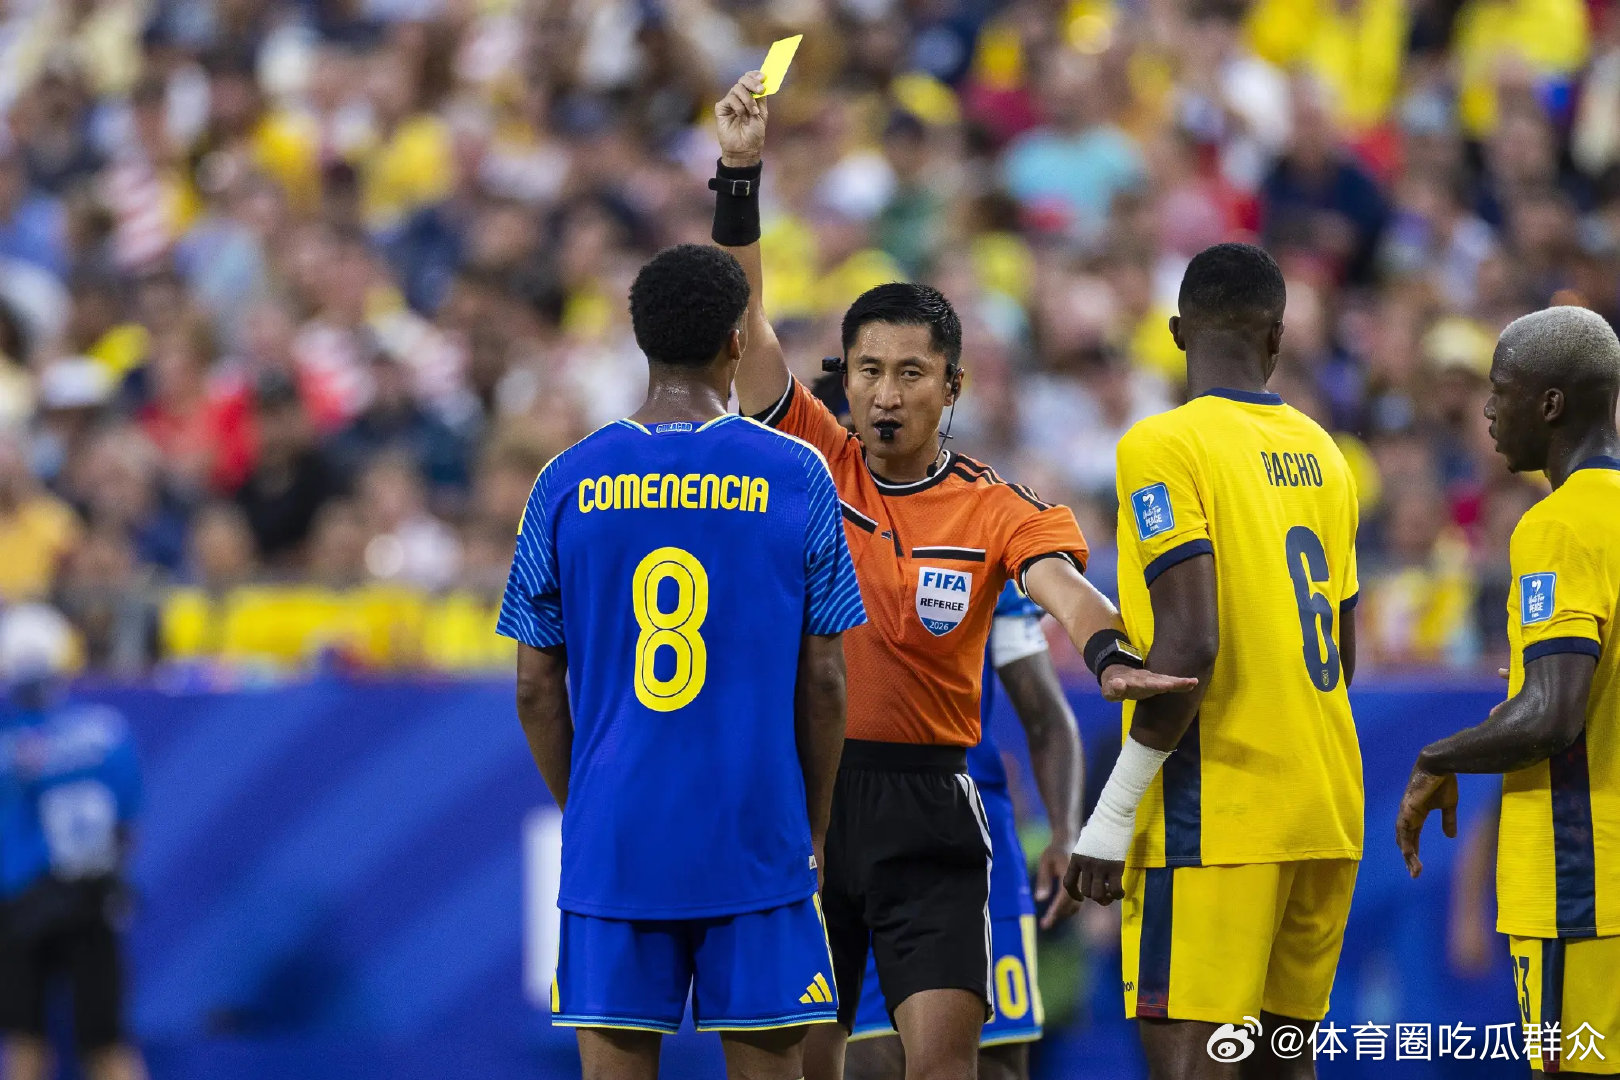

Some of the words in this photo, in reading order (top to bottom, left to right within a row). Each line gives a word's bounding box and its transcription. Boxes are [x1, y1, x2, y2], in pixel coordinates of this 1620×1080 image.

[1261, 451, 1323, 488] PACHO
[578, 473, 770, 513] COMENENCIA
[923, 571, 967, 592] FIFA
[920, 597, 965, 611] REFEREE
[1286, 525, 1340, 692] 6
[632, 546, 709, 712] 8
[929, 621, 949, 630] 2026
